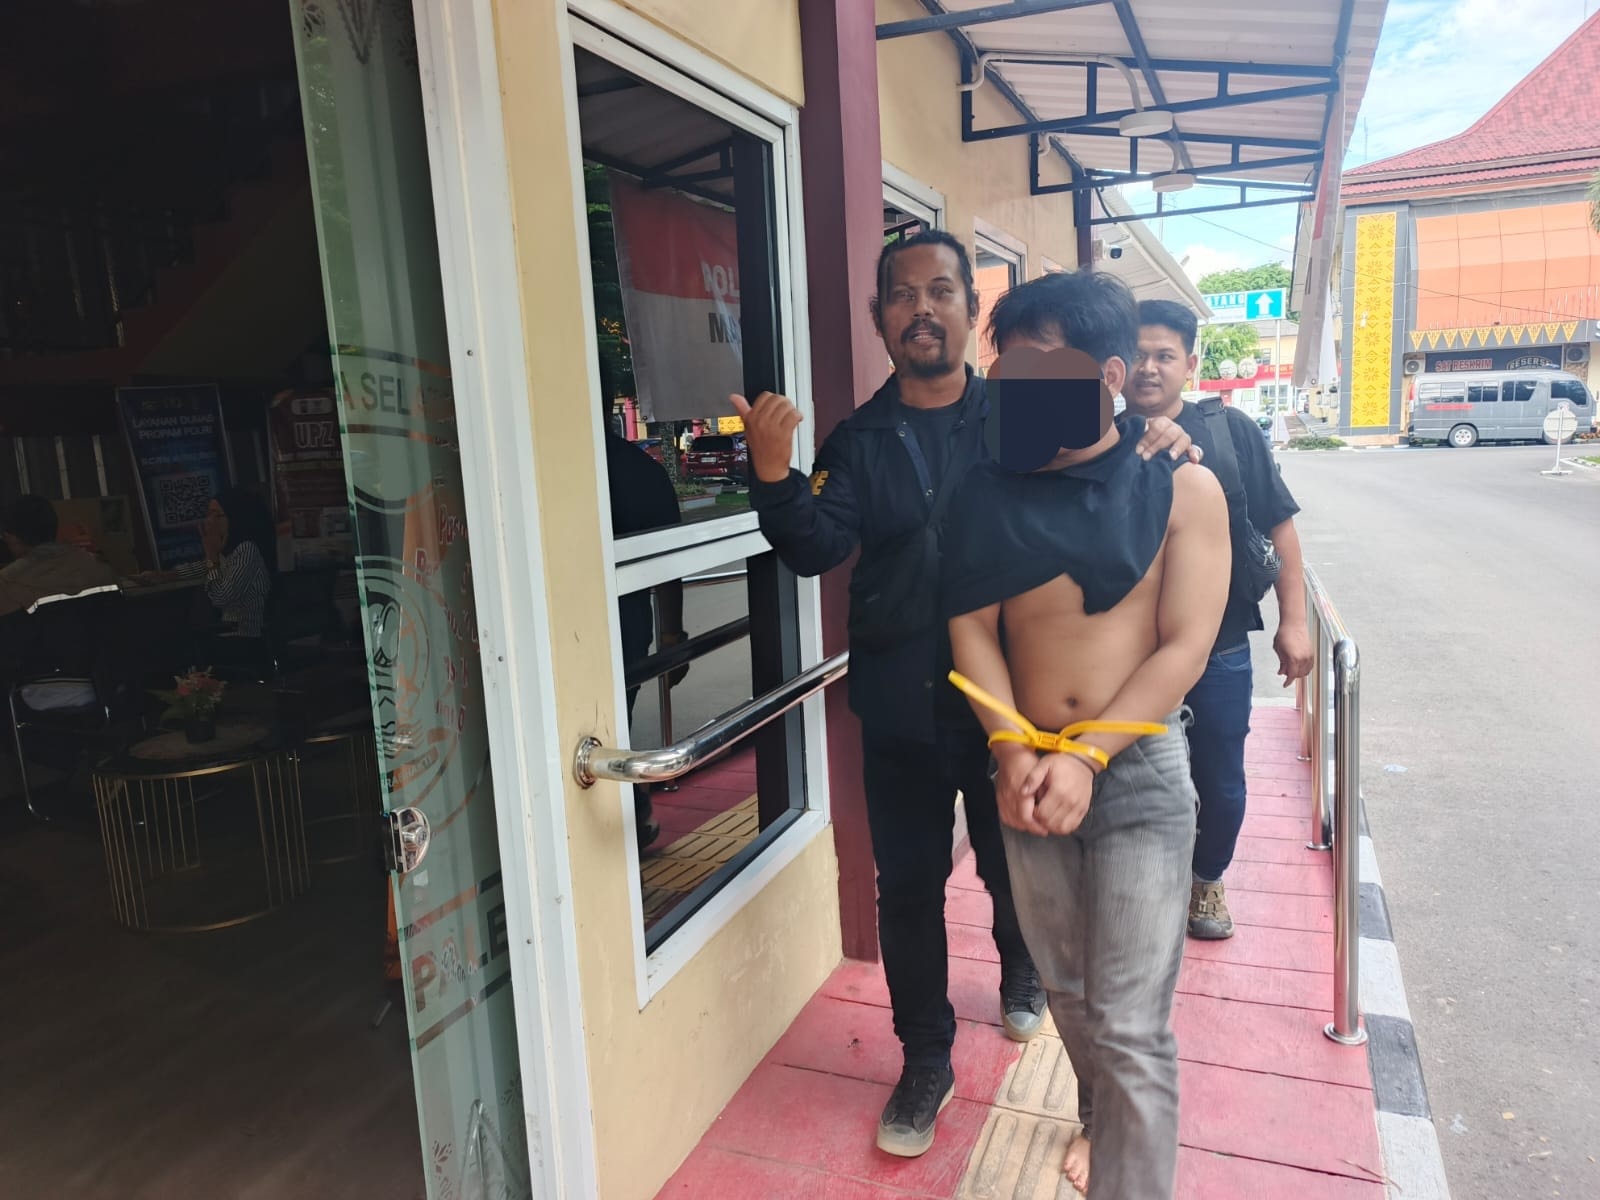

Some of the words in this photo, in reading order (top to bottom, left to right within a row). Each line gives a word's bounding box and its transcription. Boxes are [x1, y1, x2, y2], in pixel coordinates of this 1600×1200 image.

[1436, 361, 1452, 373] SAT
[1453, 358, 1493, 371] RESKRIM
[131, 415, 177, 429] LAYANAN
[138, 427, 182, 440] PROPAM
[294, 420, 336, 448] UPZ
